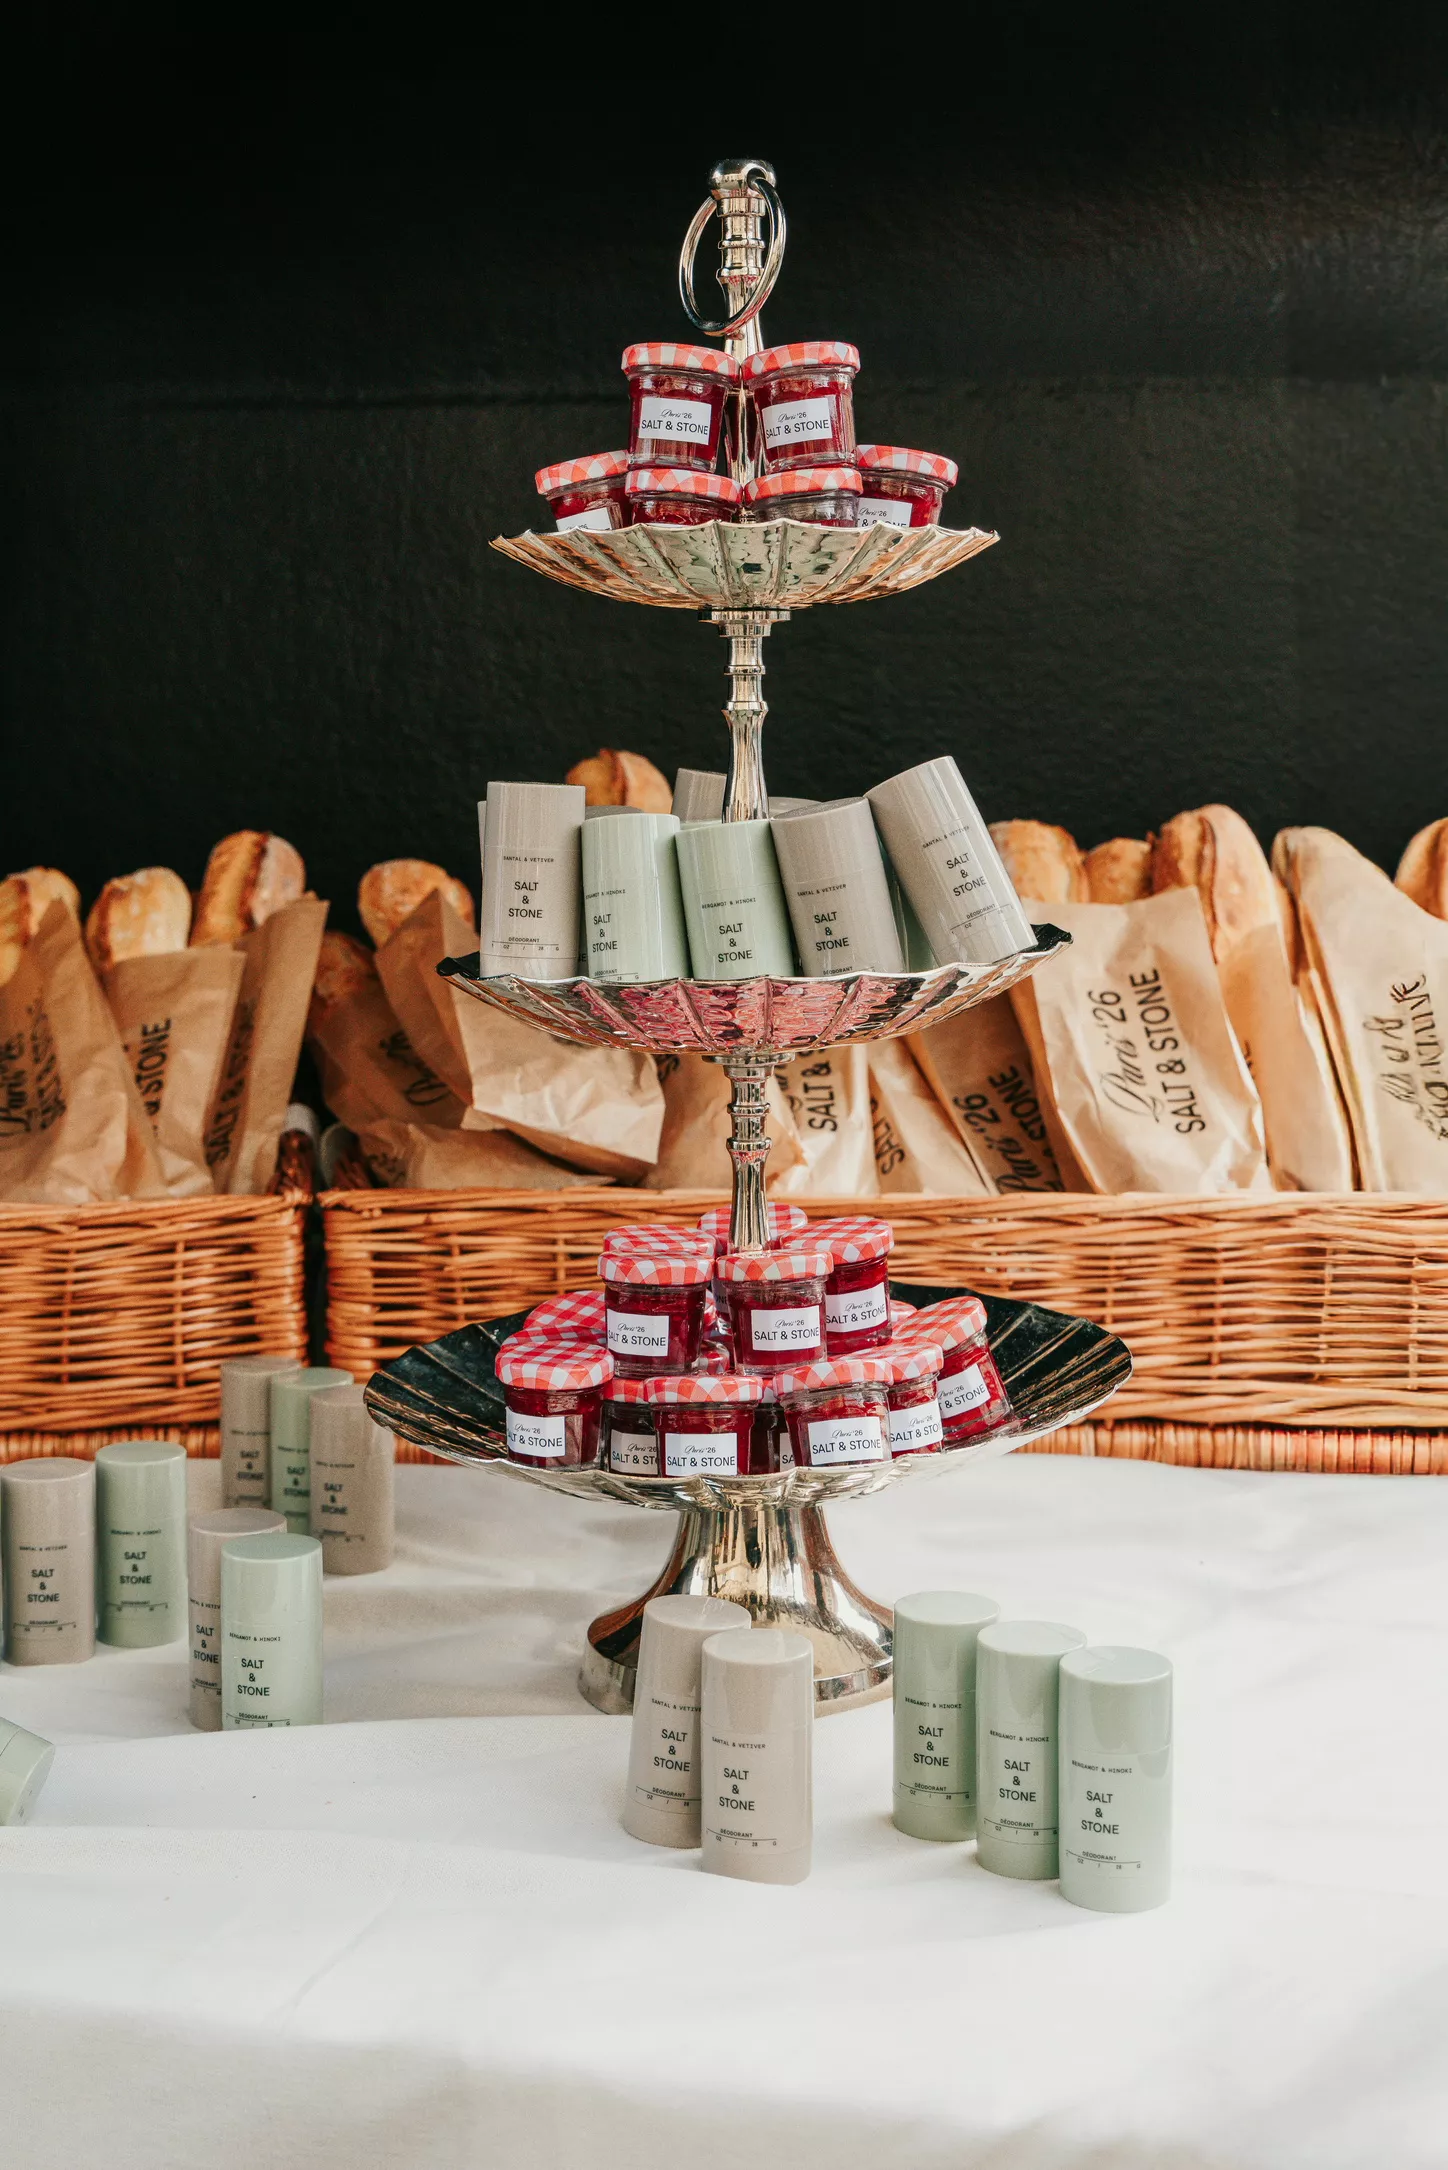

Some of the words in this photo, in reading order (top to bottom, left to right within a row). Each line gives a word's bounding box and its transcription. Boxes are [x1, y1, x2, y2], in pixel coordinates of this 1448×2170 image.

[641, 419, 663, 430] SALT
[666, 421, 673, 431] &
[676, 422, 708, 436] STONE
[766, 426, 782, 439] SALT
[784, 424, 792, 434] &
[794, 419, 830, 432] STONE
[946, 853, 970, 869] SALT
[960, 869, 968, 879] &
[514, 881, 539, 891] SALT
[953, 876, 986, 897] STONE
[522, 896, 530, 904] &
[508, 908, 543, 918] STONE
[593, 913, 611, 925] SALT
[814, 912, 838, 923] SALT
[600, 928, 605, 937] &
[719, 922, 743, 934] SALT
[825, 927, 832, 936] &
[592, 941, 618, 953] STONE
[729, 938, 737, 947] &
[816, 937, 850, 951] STONE
[717, 950, 753, 963] STONE
[1129, 968, 1178, 1051] STONE
[134, 1018, 172, 1096] STONE
[800, 1060, 832, 1077] &
[1156, 1058, 1186, 1074] &
[803, 1081, 839, 1132] SALT
[952, 1093, 1001, 1133] '26
[1161, 1081, 1206, 1133] SALT
[826, 1315, 848, 1324] SALT
[851, 1313, 858, 1322] &
[861, 1303, 886, 1320] STONE
[621, 1334, 628, 1344] &
[631, 1335, 667, 1347] STONE
[754, 1331, 778, 1341] SALT
[780, 1330, 788, 1339] &
[791, 1327, 820, 1339] STONE
[945, 1400, 953, 1409] &
[954, 1384, 986, 1406] STONE
[519, 1435, 526, 1444] &
[528, 1436, 562, 1448] STONE
[890, 1431, 913, 1442] SALT
[916, 1429, 922, 1438] &
[812, 1442, 835, 1455] SALT
[839, 1441, 846, 1451] &
[850, 1439, 881, 1451] STONE
[612, 1451, 630, 1464] SALT
[633, 1455, 640, 1464] &
[667, 1455, 687, 1466] SALT
[690, 1457, 697, 1467] &
[701, 1456, 735, 1467] STONE
[124, 1551, 147, 1560] SALT
[31, 1569, 54, 1578] SALT
[131, 1564, 138, 1572] &
[39, 1581, 46, 1591] &
[119, 1575, 152, 1584] STONE
[27, 1593, 60, 1603] STONE
[196, 1624, 214, 1637] SALT
[201, 1639, 207, 1648] &
[193, 1650, 219, 1664] STONE
[241, 1658, 264, 1669] SALT
[248, 1672, 256, 1682] &
[237, 1684, 270, 1697] STONE
[661, 1729, 688, 1742] SALT
[918, 1725, 944, 1738] SALT
[668, 1745, 676, 1755] &
[926, 1741, 934, 1751] &
[653, 1756, 691, 1771] STONE
[913, 1753, 950, 1767] STONE
[1004, 1759, 1030, 1772] SALT
[723, 1768, 749, 1780] SALT
[1013, 1776, 1021, 1786] &
[732, 1784, 739, 1795] &
[999, 1788, 1037, 1802] STONE
[719, 1796, 755, 1811] STONE
[1086, 1791, 1113, 1803] SALT
[1095, 1807, 1103, 1818] &
[1081, 1819, 1119, 1835] STONE
